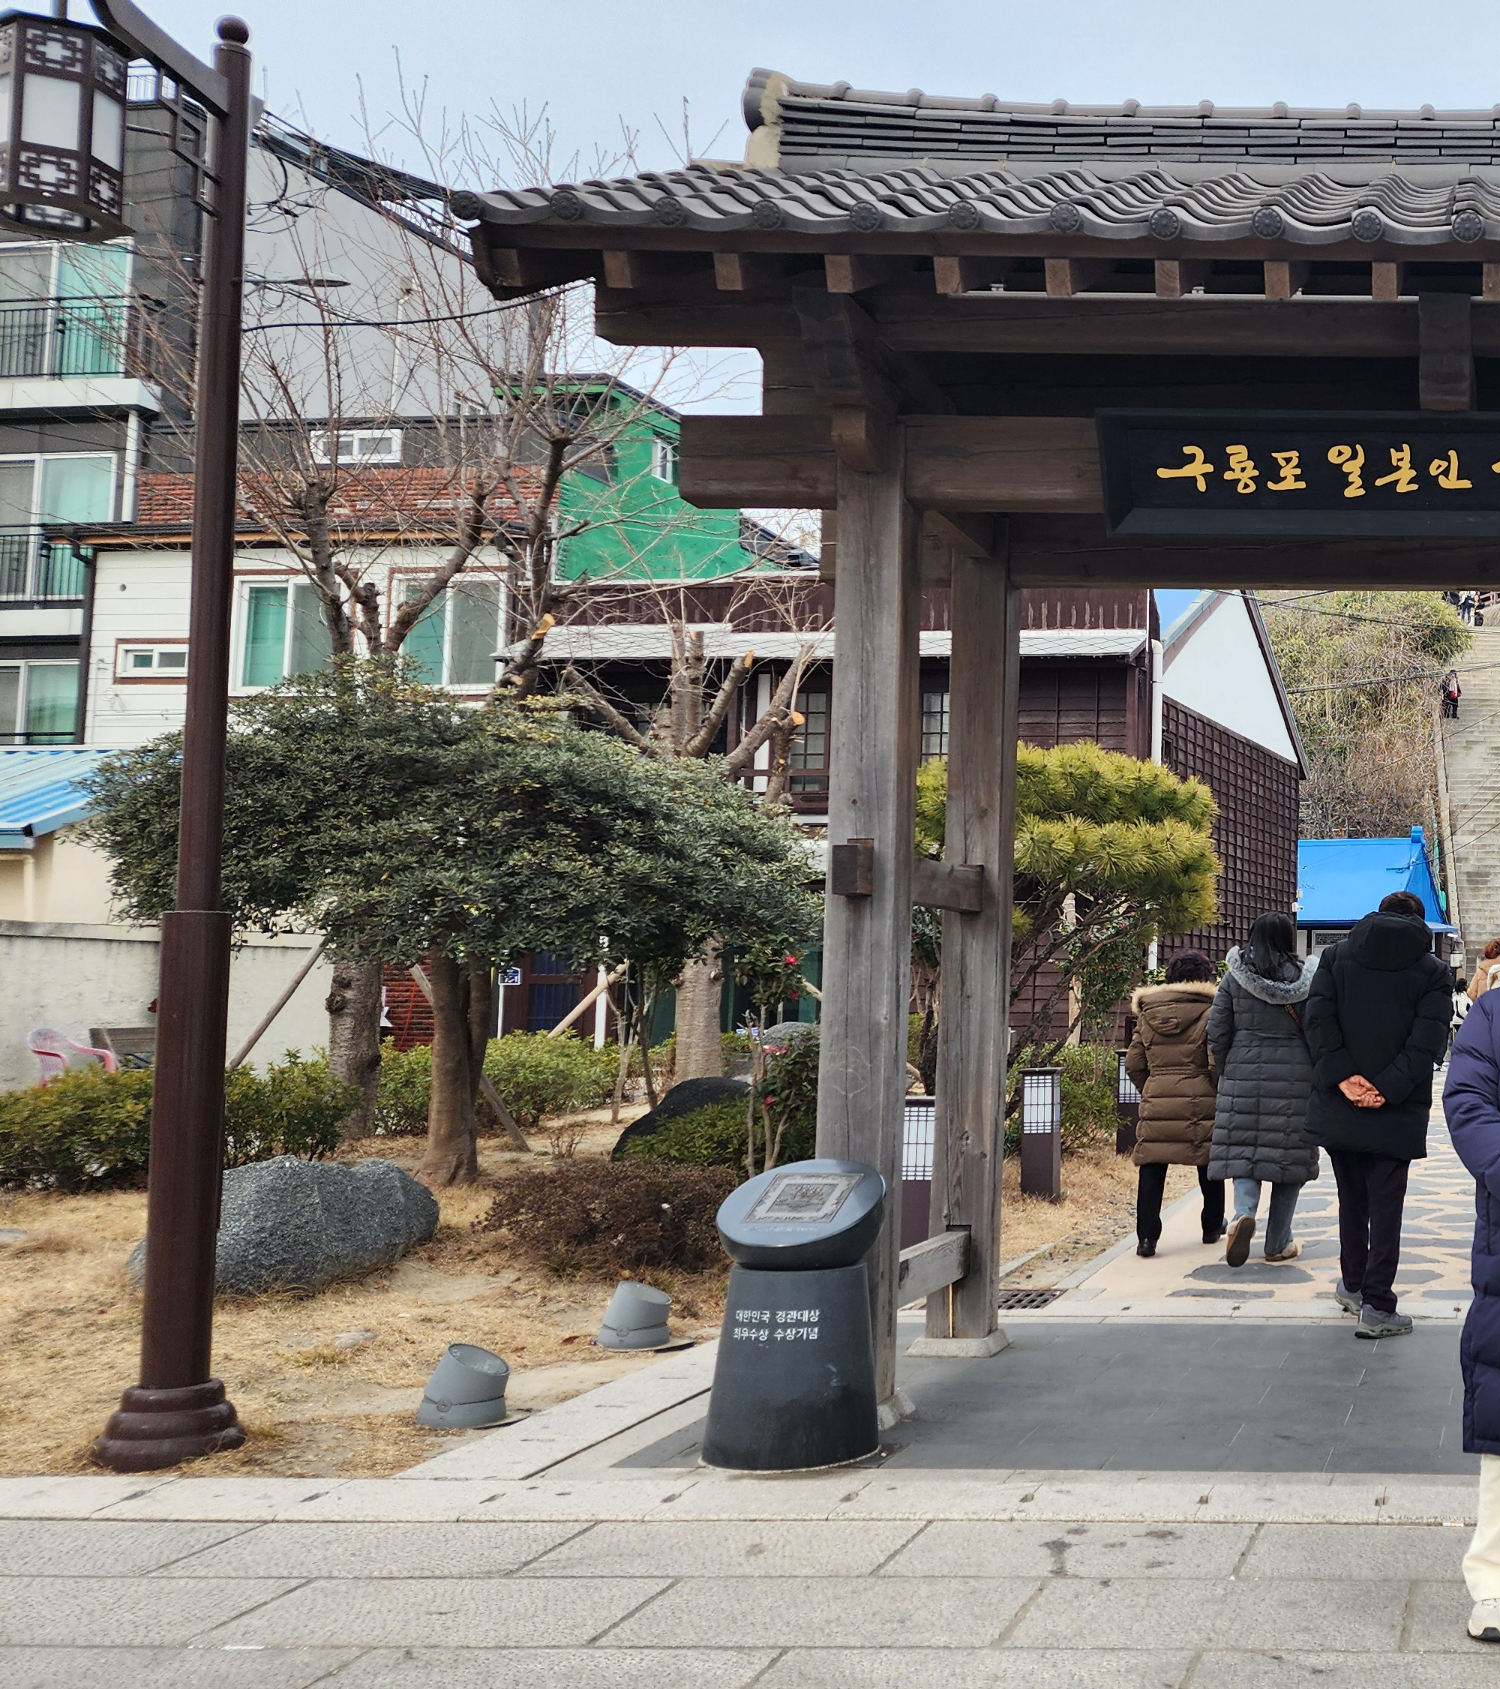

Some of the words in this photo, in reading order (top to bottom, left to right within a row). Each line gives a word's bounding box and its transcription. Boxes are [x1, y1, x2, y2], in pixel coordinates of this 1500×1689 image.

[1156, 444, 1307, 494] 구룡포
[1327, 443, 1473, 498] 일본인
[735, 1309, 770, 1324] 대한민국
[775, 1309, 820, 1323] 경관대상
[733, 1327, 769, 1341] 최우수상
[773, 1327, 819, 1341] 수상기념
